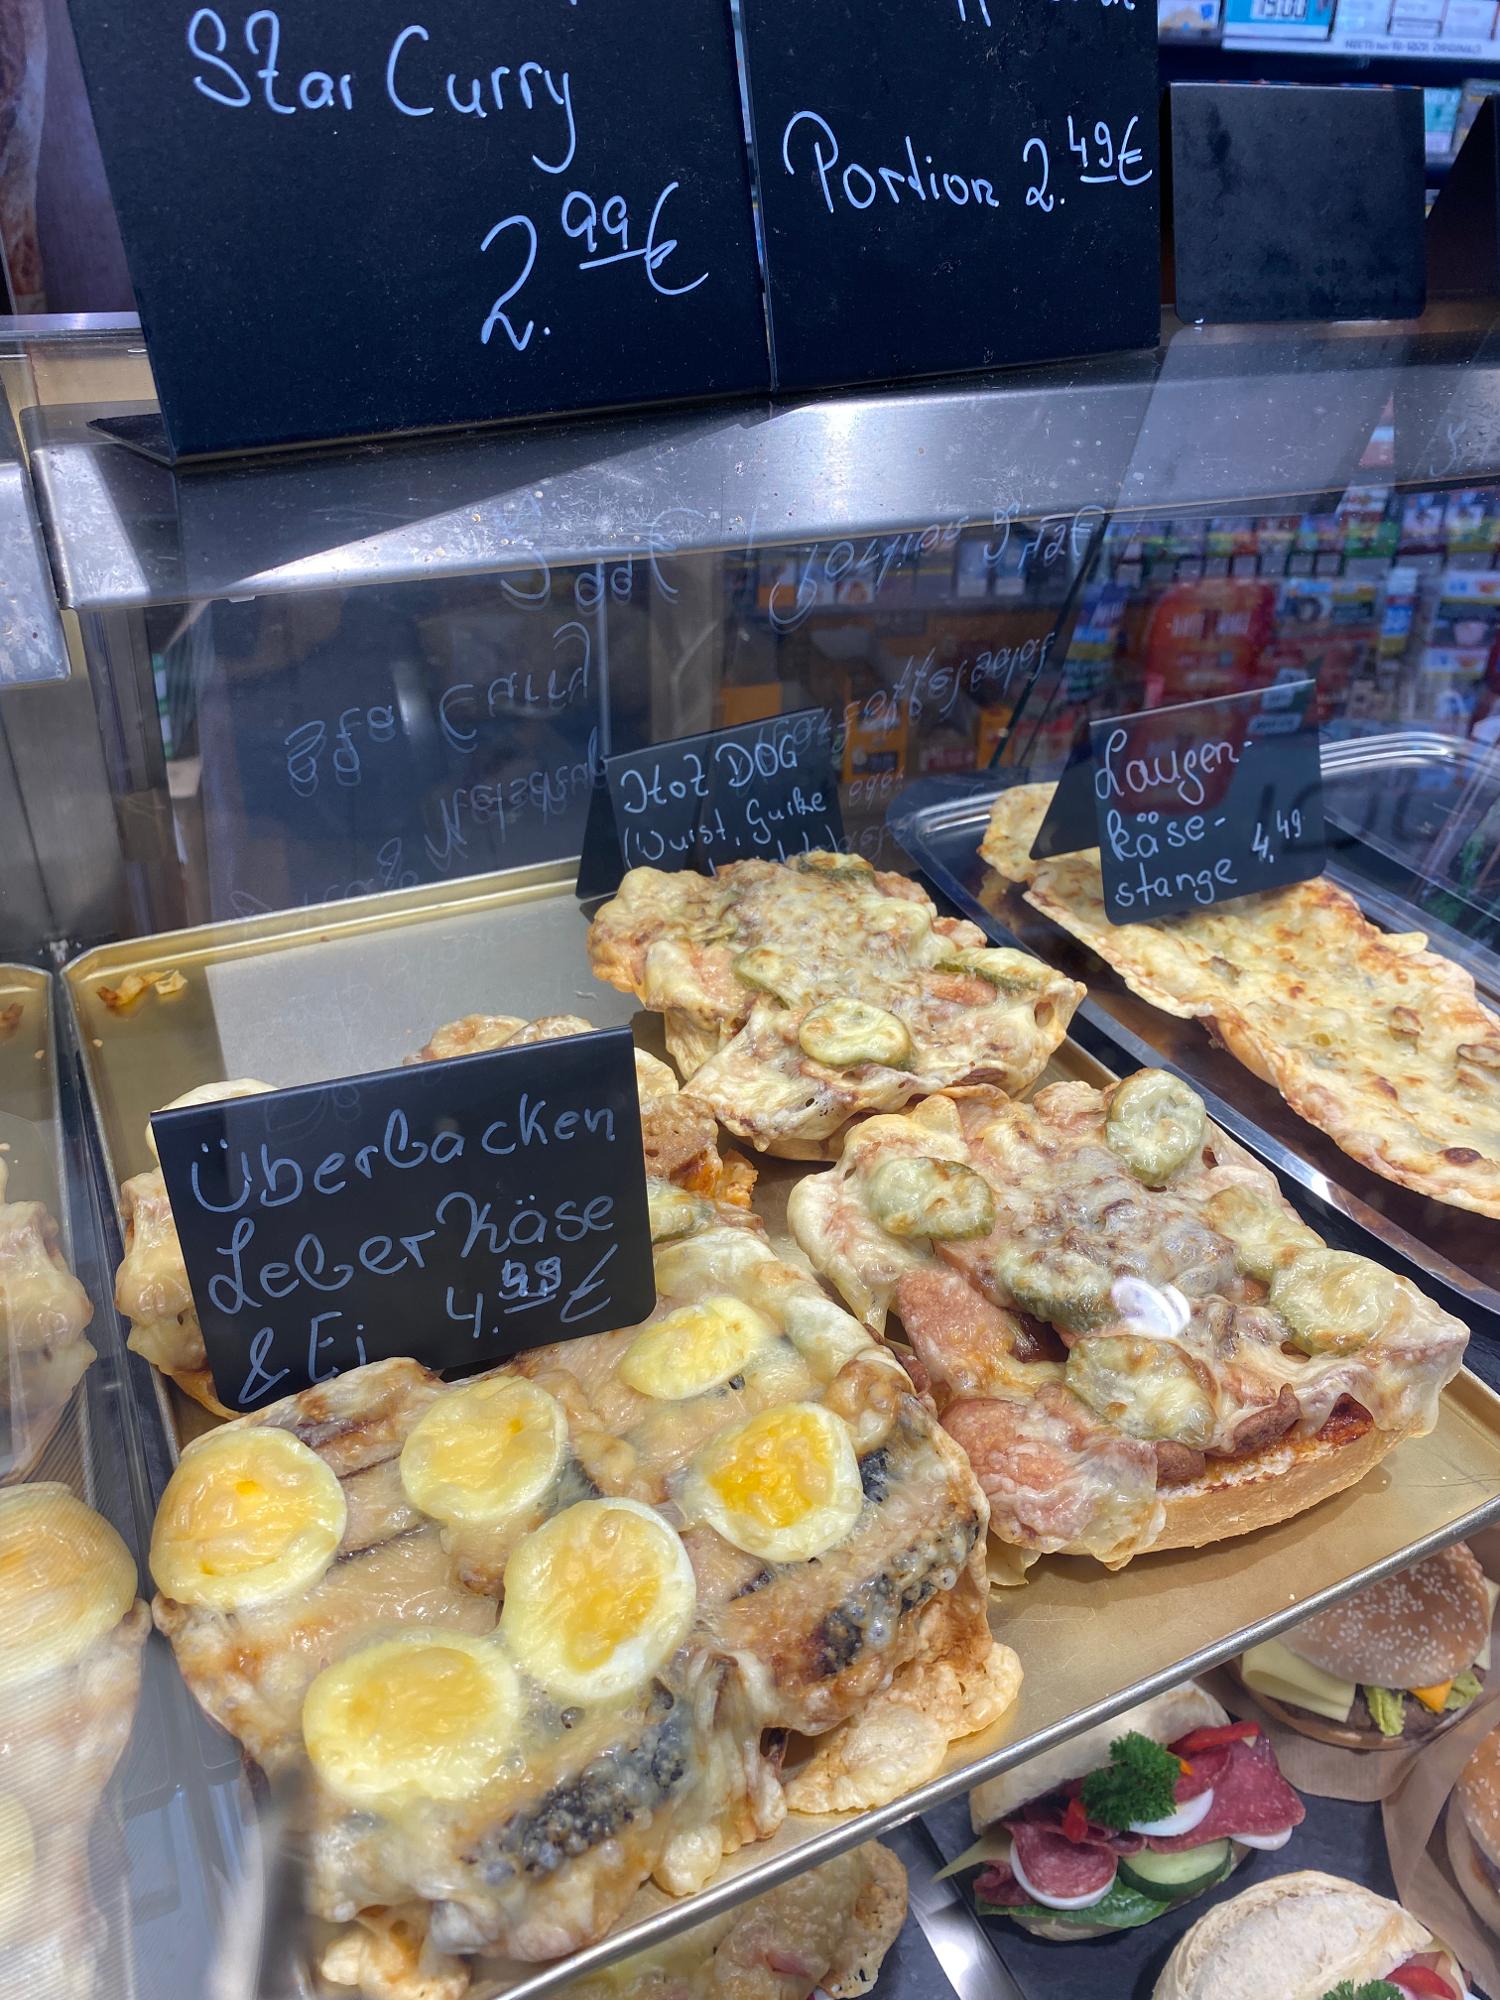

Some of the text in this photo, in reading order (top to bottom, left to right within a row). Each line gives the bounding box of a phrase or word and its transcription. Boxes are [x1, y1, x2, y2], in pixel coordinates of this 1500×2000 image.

[188, 8, 576, 174] Star Curry
[783, 111, 1000, 213] Portion
[715, 734, 797, 787] DOG
[746, 787, 827, 844] Gurke
[1115, 858, 1237, 906] stange
[191, 1093, 617, 1213] Überbacken
[238, 1327, 290, 1405] &
